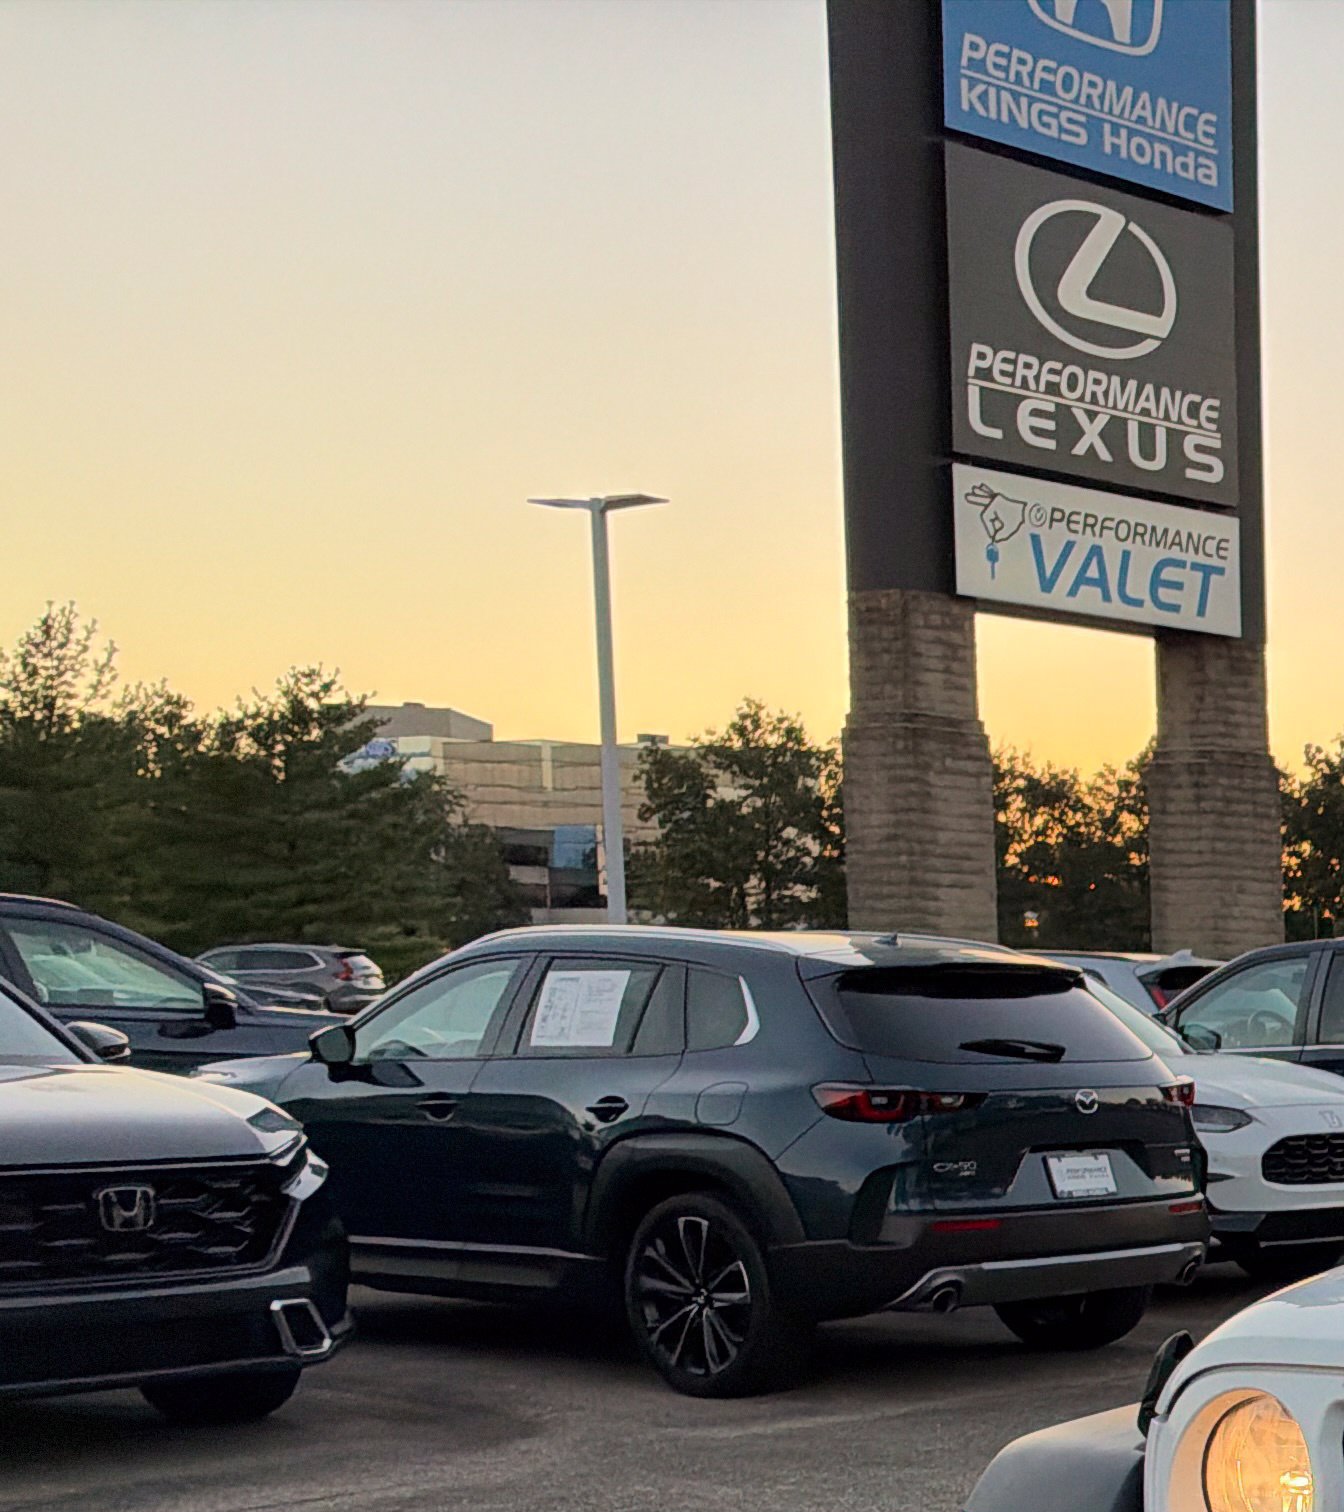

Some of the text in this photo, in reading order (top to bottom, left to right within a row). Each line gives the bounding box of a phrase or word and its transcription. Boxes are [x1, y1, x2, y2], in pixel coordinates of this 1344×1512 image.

[960, 32, 1218, 147] PERFORMANCE
[960, 77, 1219, 188] KINGS Honda
[967, 342, 1222, 431] PERFORMANCE
[967, 384, 1225, 484] LEXUS
[1029, 532, 1226, 618] VALET
[1049, 507, 1231, 561] PERFORMANCE
